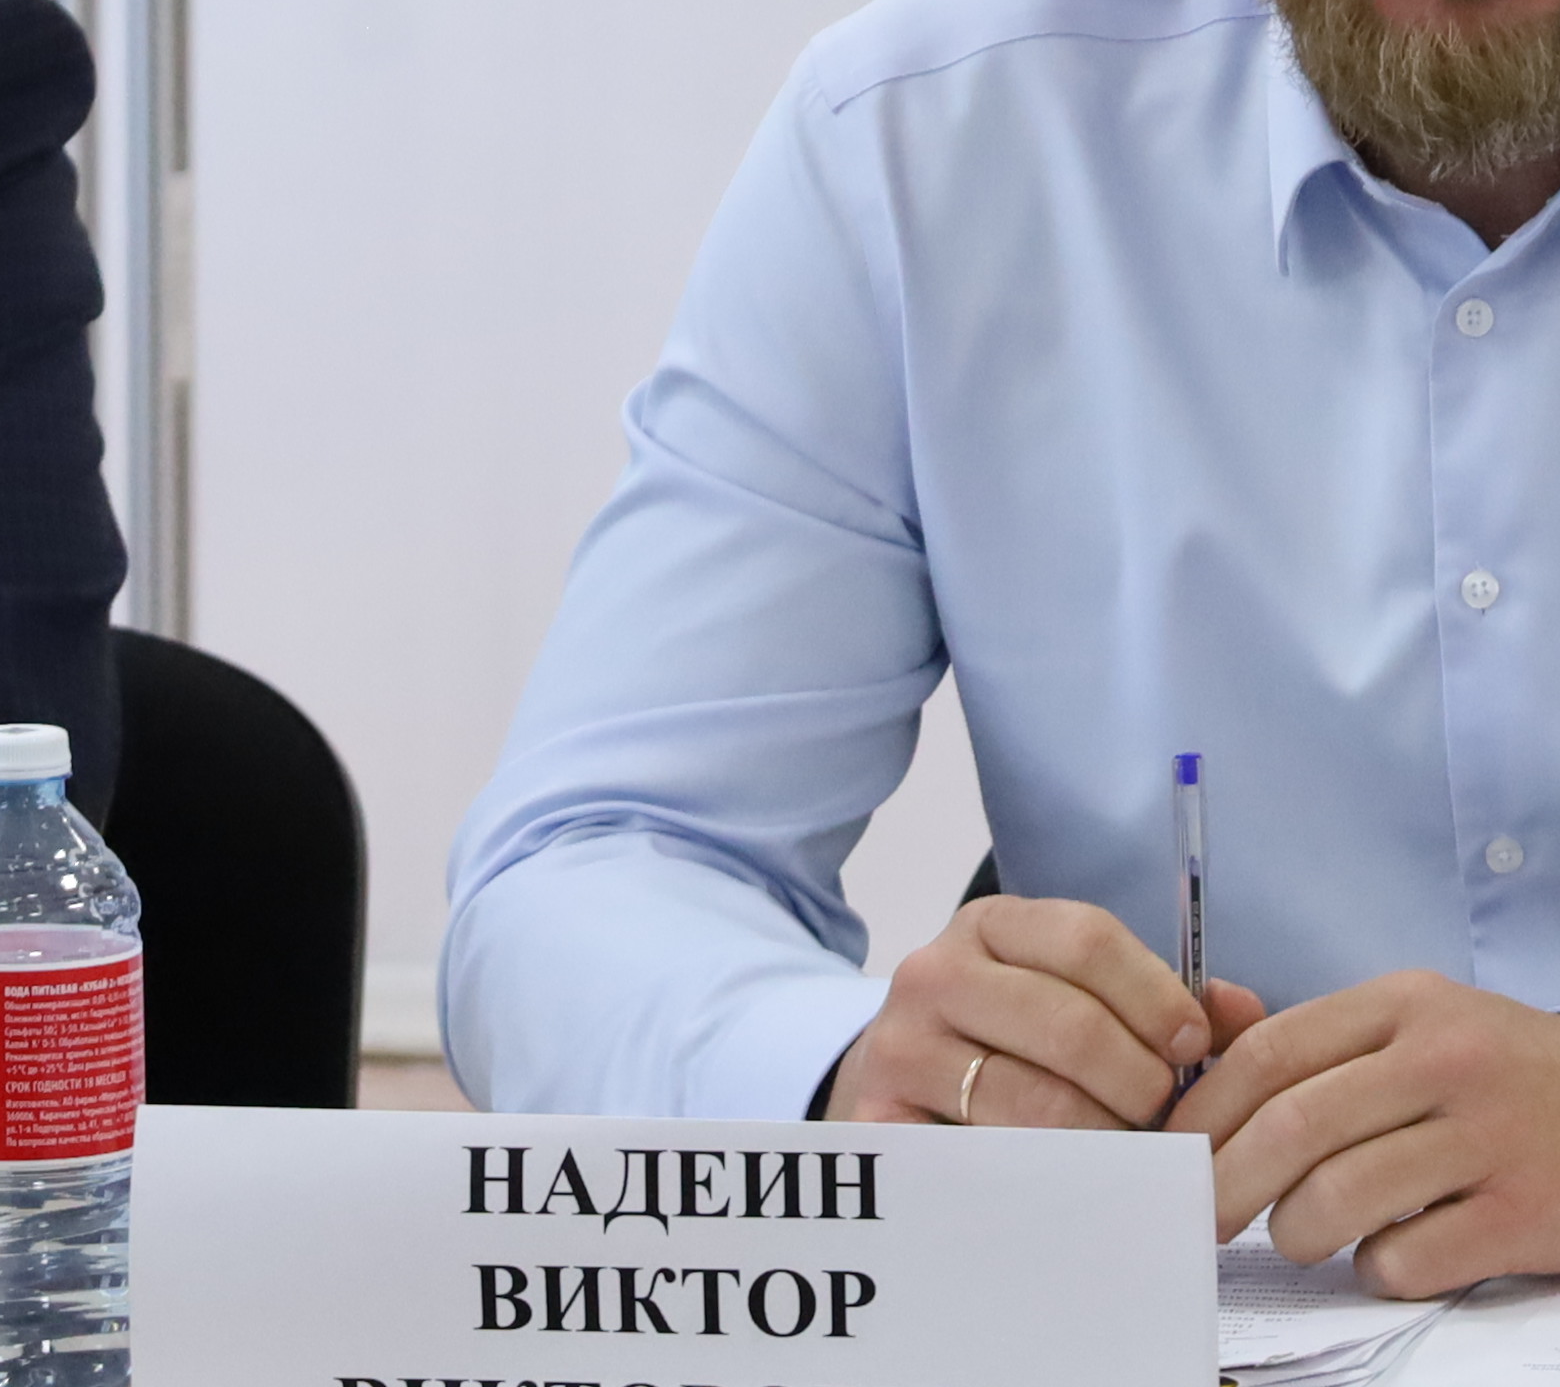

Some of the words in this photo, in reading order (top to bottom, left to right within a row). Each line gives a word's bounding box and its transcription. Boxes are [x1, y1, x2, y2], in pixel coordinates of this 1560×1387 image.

[4, 985, 30, 997] ВОДА
[31, 983, 78, 997] ПИТЬЕВАЯ
[5, 1081, 31, 1094] СРОК
[32, 1076, 82, 1093] ГОДНОСТИ
[460, 1145, 885, 1236] НАДЕИН
[472, 1263, 877, 1339] ВИКТОР
